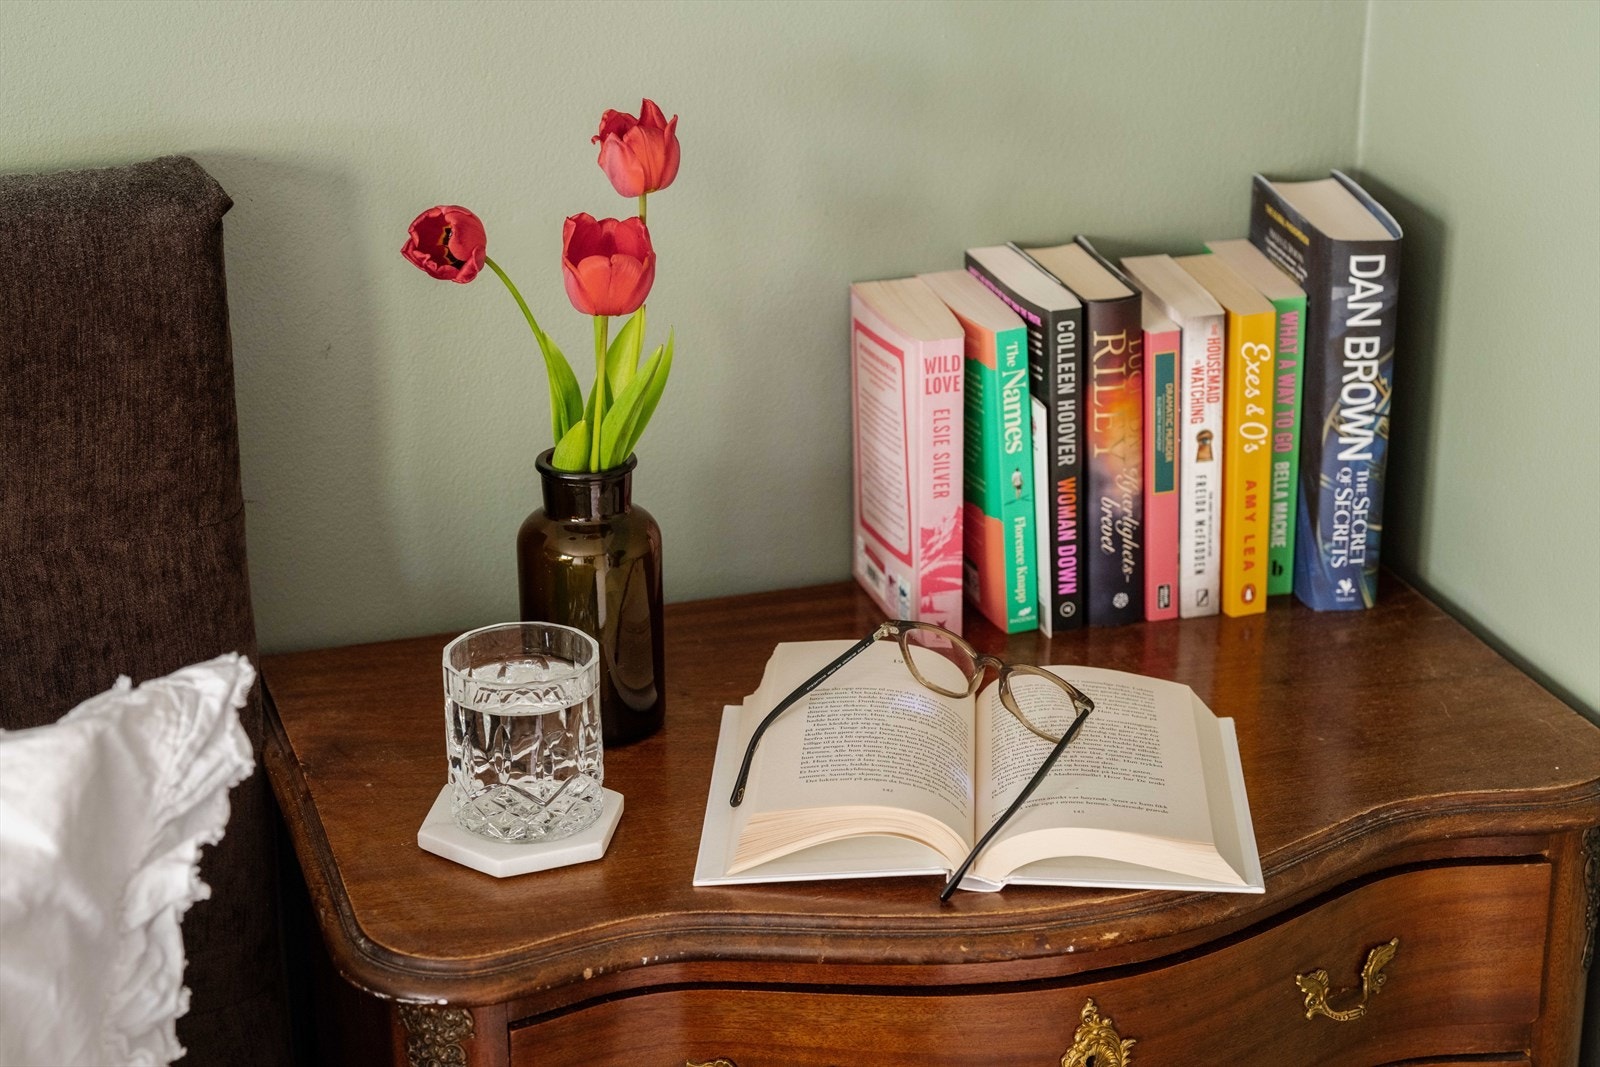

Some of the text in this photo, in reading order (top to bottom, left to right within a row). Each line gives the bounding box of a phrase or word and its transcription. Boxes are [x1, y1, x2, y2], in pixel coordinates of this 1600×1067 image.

[924, 354, 961, 375] WILD
[925, 374, 961, 395] LOVE
[1002, 341, 1026, 455] The Names
[1057, 320, 1076, 466] COLLEEN HOOVER
[1093, 329, 1127, 461] RILEY
[1191, 365, 1205, 424] WATCHING
[1206, 337, 1221, 404] HOUSEMAID
[1241, 341, 1271, 398] Exes
[1274, 311, 1298, 453] WHAT A WAY TO GO
[1337, 255, 1386, 461] DAN BROWN
[1165, 383, 1174, 426] DRAMATIC
[1245, 403, 1265, 416] &
[932, 408, 950, 499] ELSIE SILVER
[1014, 516, 1026, 565] Florence
[1057, 476, 1077, 595] WOMAN DOWN
[1100, 496, 1120, 555] brevet
[1194, 475, 1207, 575] FREIDA McFADDEN
[1243, 480, 1257, 571] AMY LEA
[1270, 461, 1290, 548] BELLA MACKIE
[1330, 487, 1354, 568] SECRETS
[1349, 468, 1371, 566] THE SECRET
[1014, 565, 1028, 604] Knapp
